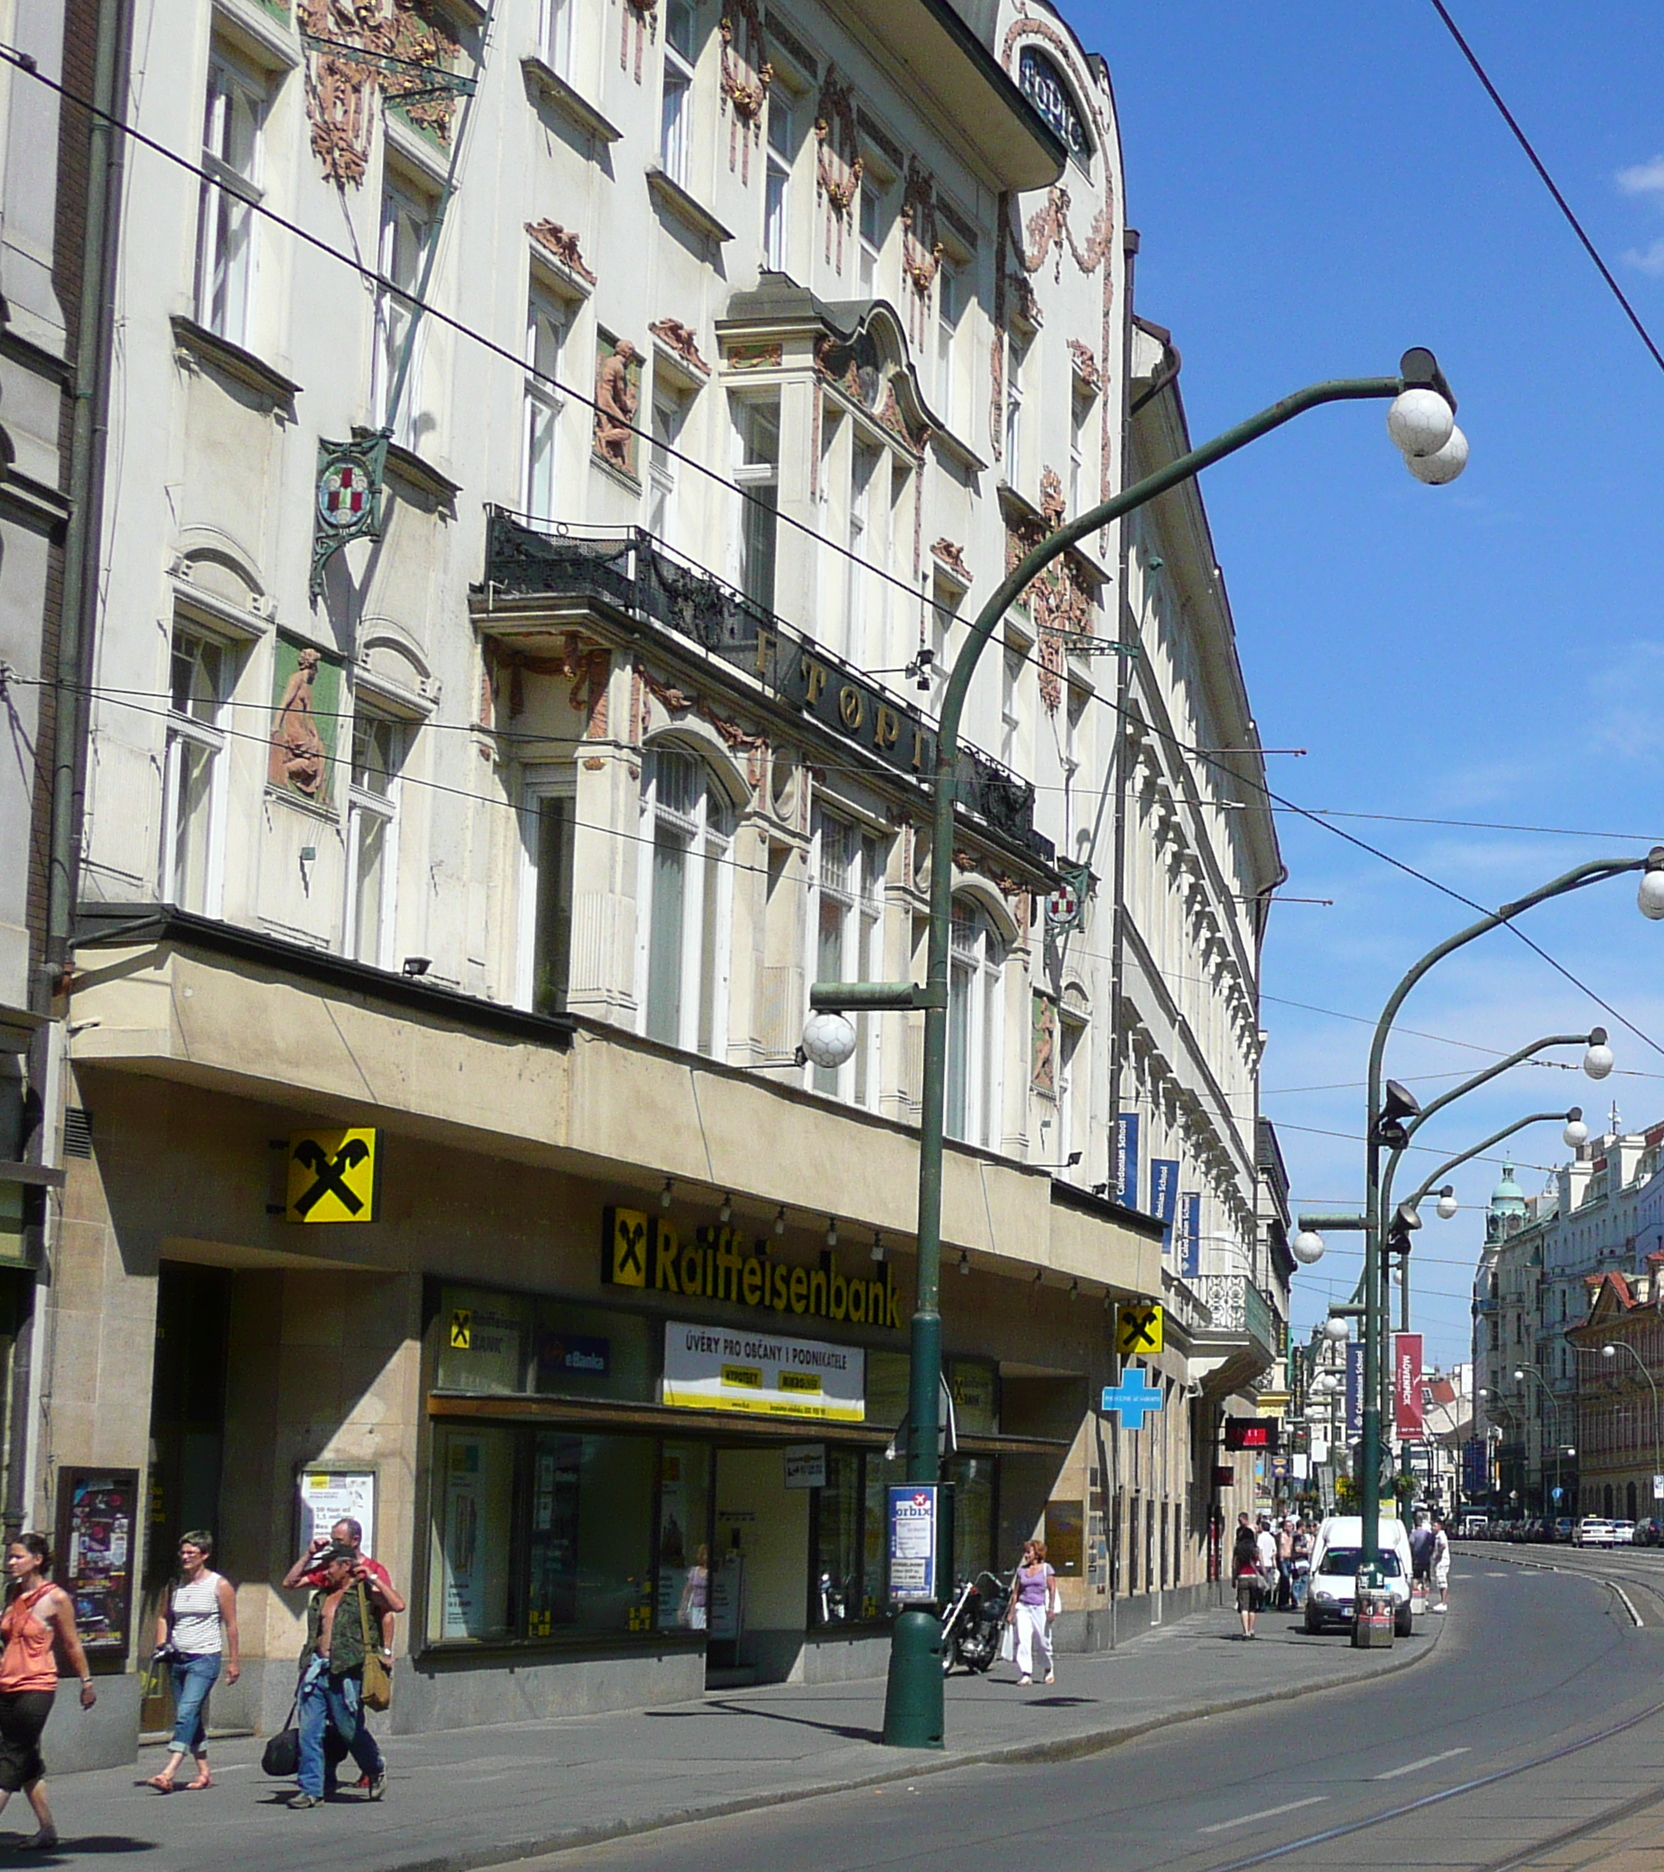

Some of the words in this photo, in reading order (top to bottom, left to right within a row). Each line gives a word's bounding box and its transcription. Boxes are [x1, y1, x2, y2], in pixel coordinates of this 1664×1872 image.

[802, 656, 922, 769] TOPI
[1117, 1120, 1127, 1148] School
[1116, 1149, 1126, 1196] Caledonian
[1158, 1165, 1169, 1191] School
[1154, 1192, 1166, 1219] donian
[655, 1217, 902, 1330] Raiffeisenbank
[686, 1330, 720, 1355] ÚVĚRY
[724, 1338, 742, 1357] PRO
[745, 1339, 782, 1363] OBČANY
[785, 1347, 790, 1362] I
[793, 1348, 847, 1372] PODNIKATELE
[1354, 1350, 1364, 1374] School
[896, 1505, 931, 1518] orbix
